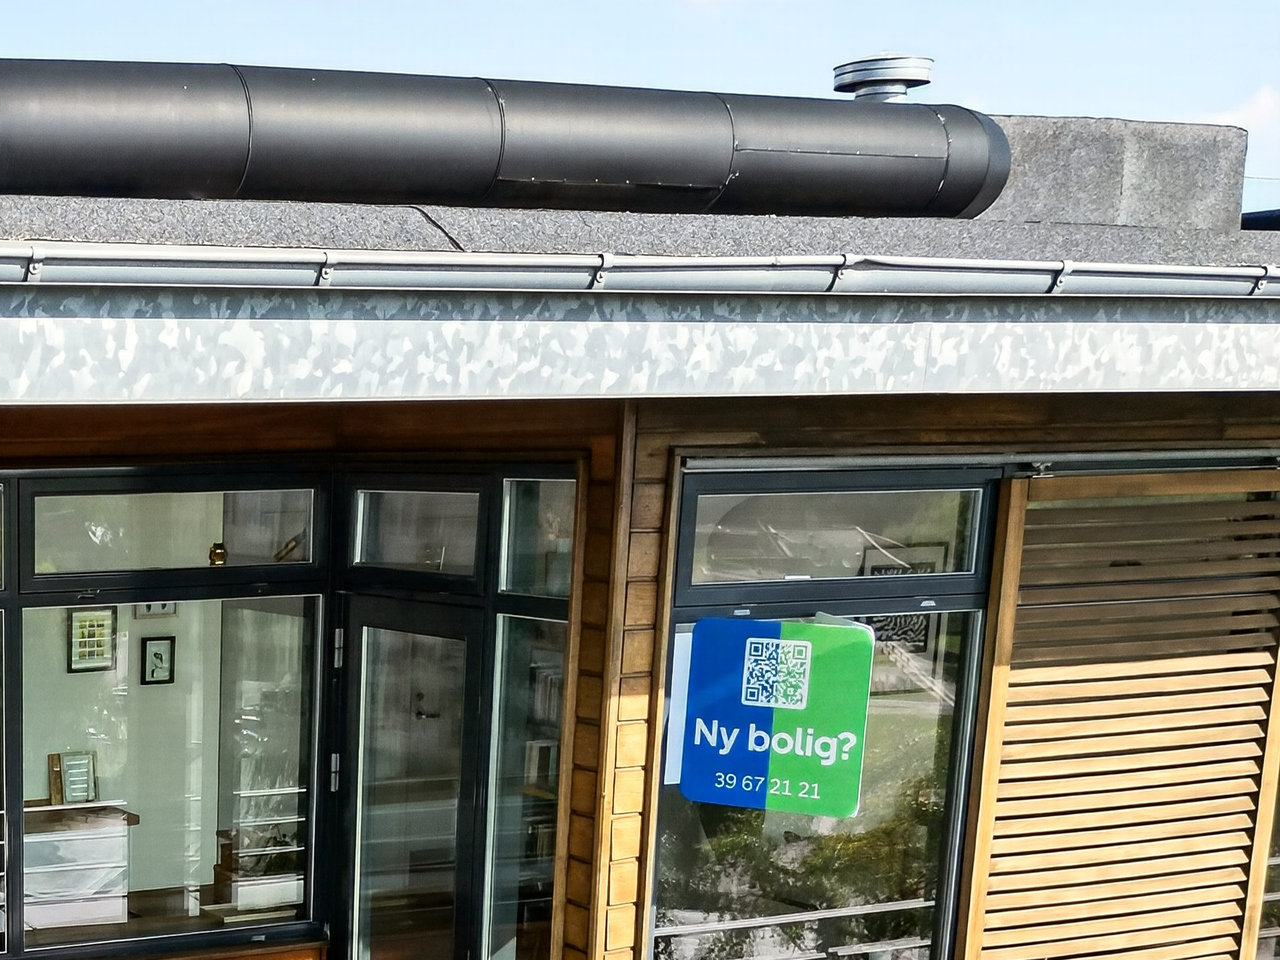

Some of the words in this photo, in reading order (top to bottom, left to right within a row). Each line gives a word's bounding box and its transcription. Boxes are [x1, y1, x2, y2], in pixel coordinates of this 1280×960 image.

[694, 717, 740, 756] Ny
[747, 723, 857, 766] bolig?
[714, 772, 737, 789] 39
[741, 775, 766, 792] 67
[769, 778, 792, 796] 21
[797, 781, 821, 799] 21
